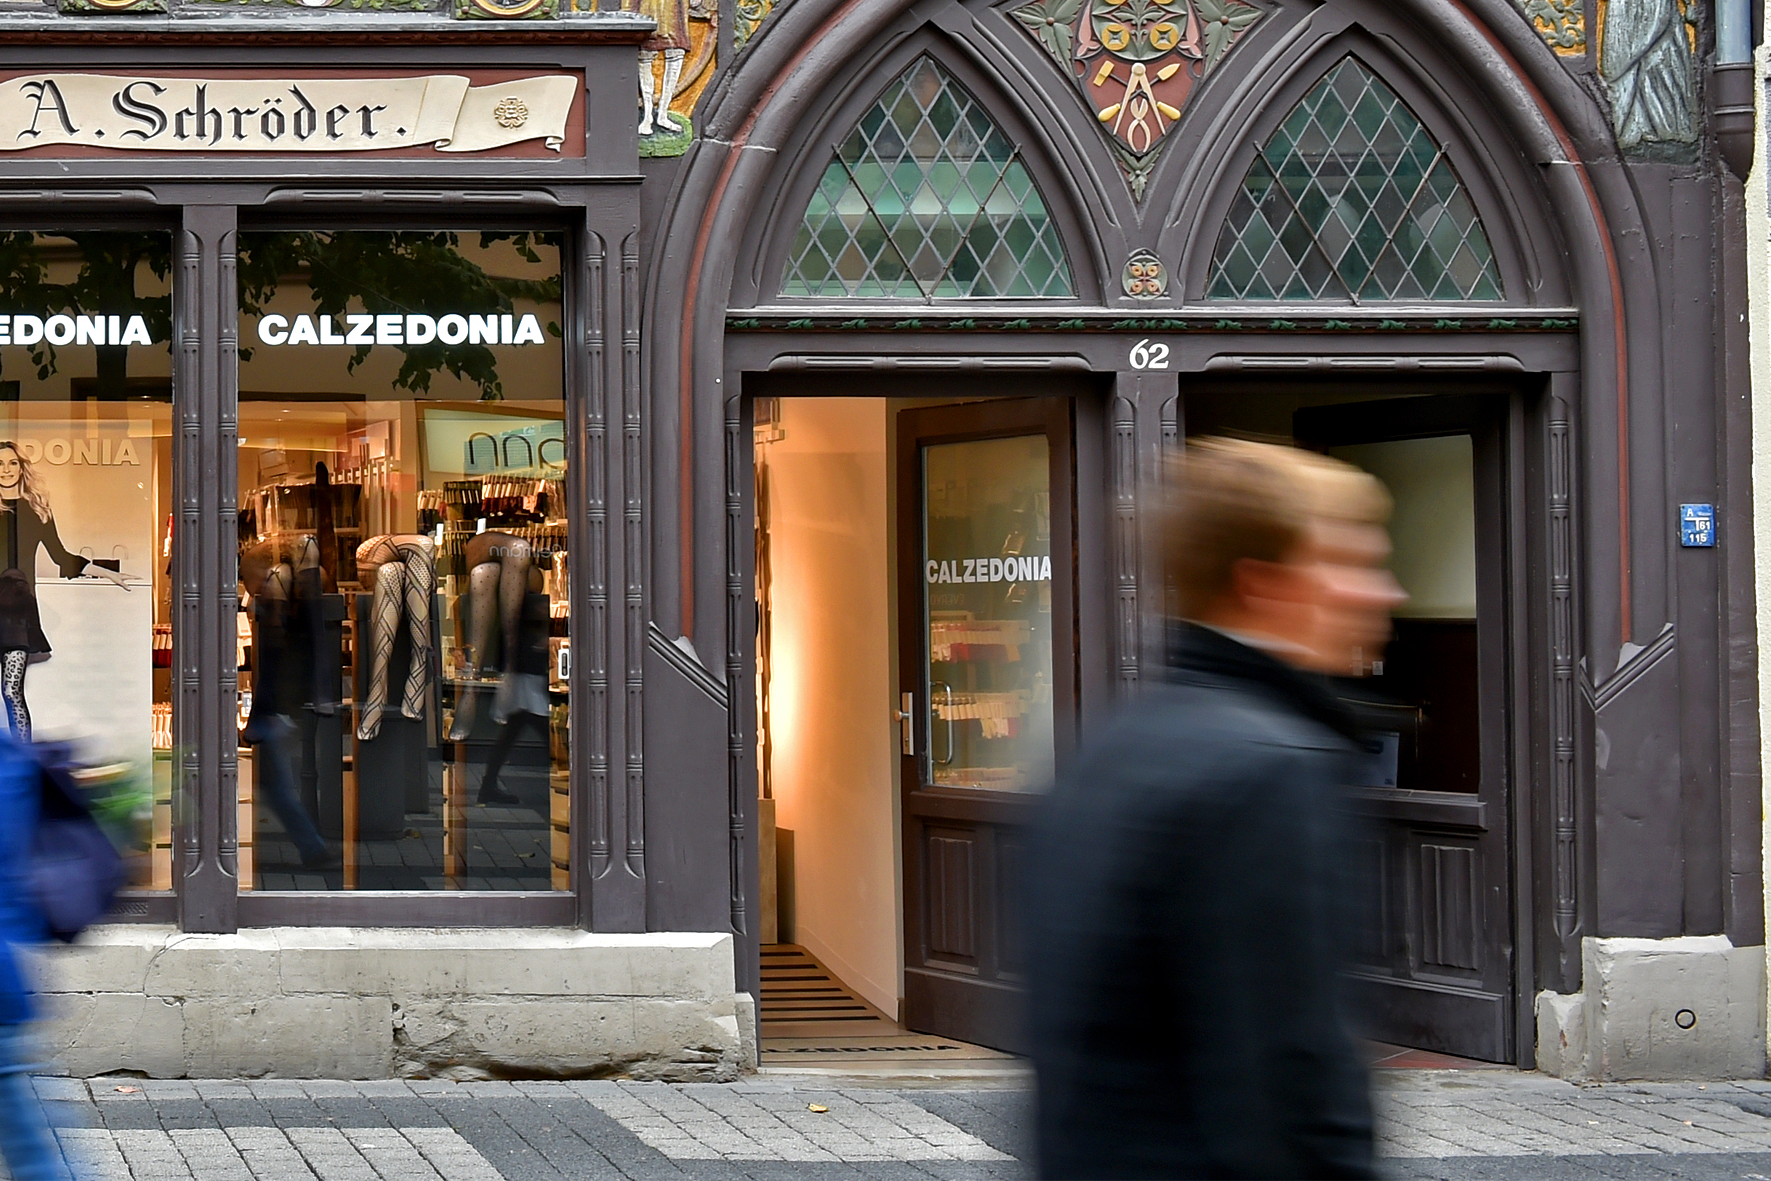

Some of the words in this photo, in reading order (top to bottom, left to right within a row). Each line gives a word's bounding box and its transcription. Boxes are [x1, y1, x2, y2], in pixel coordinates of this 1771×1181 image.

[16, 79, 106, 142] A.
[112, 81, 407, 147] Schröder.
[257, 313, 545, 345] CALZEDONIA
[1129, 338, 1170, 370] 62
[1686, 508, 1694, 516] A
[1699, 521, 1710, 530] 61
[1689, 533, 1707, 543] 115
[926, 556, 1052, 584] CALZEDONIA
[761, 1044, 962, 1054] LZEDONIA
